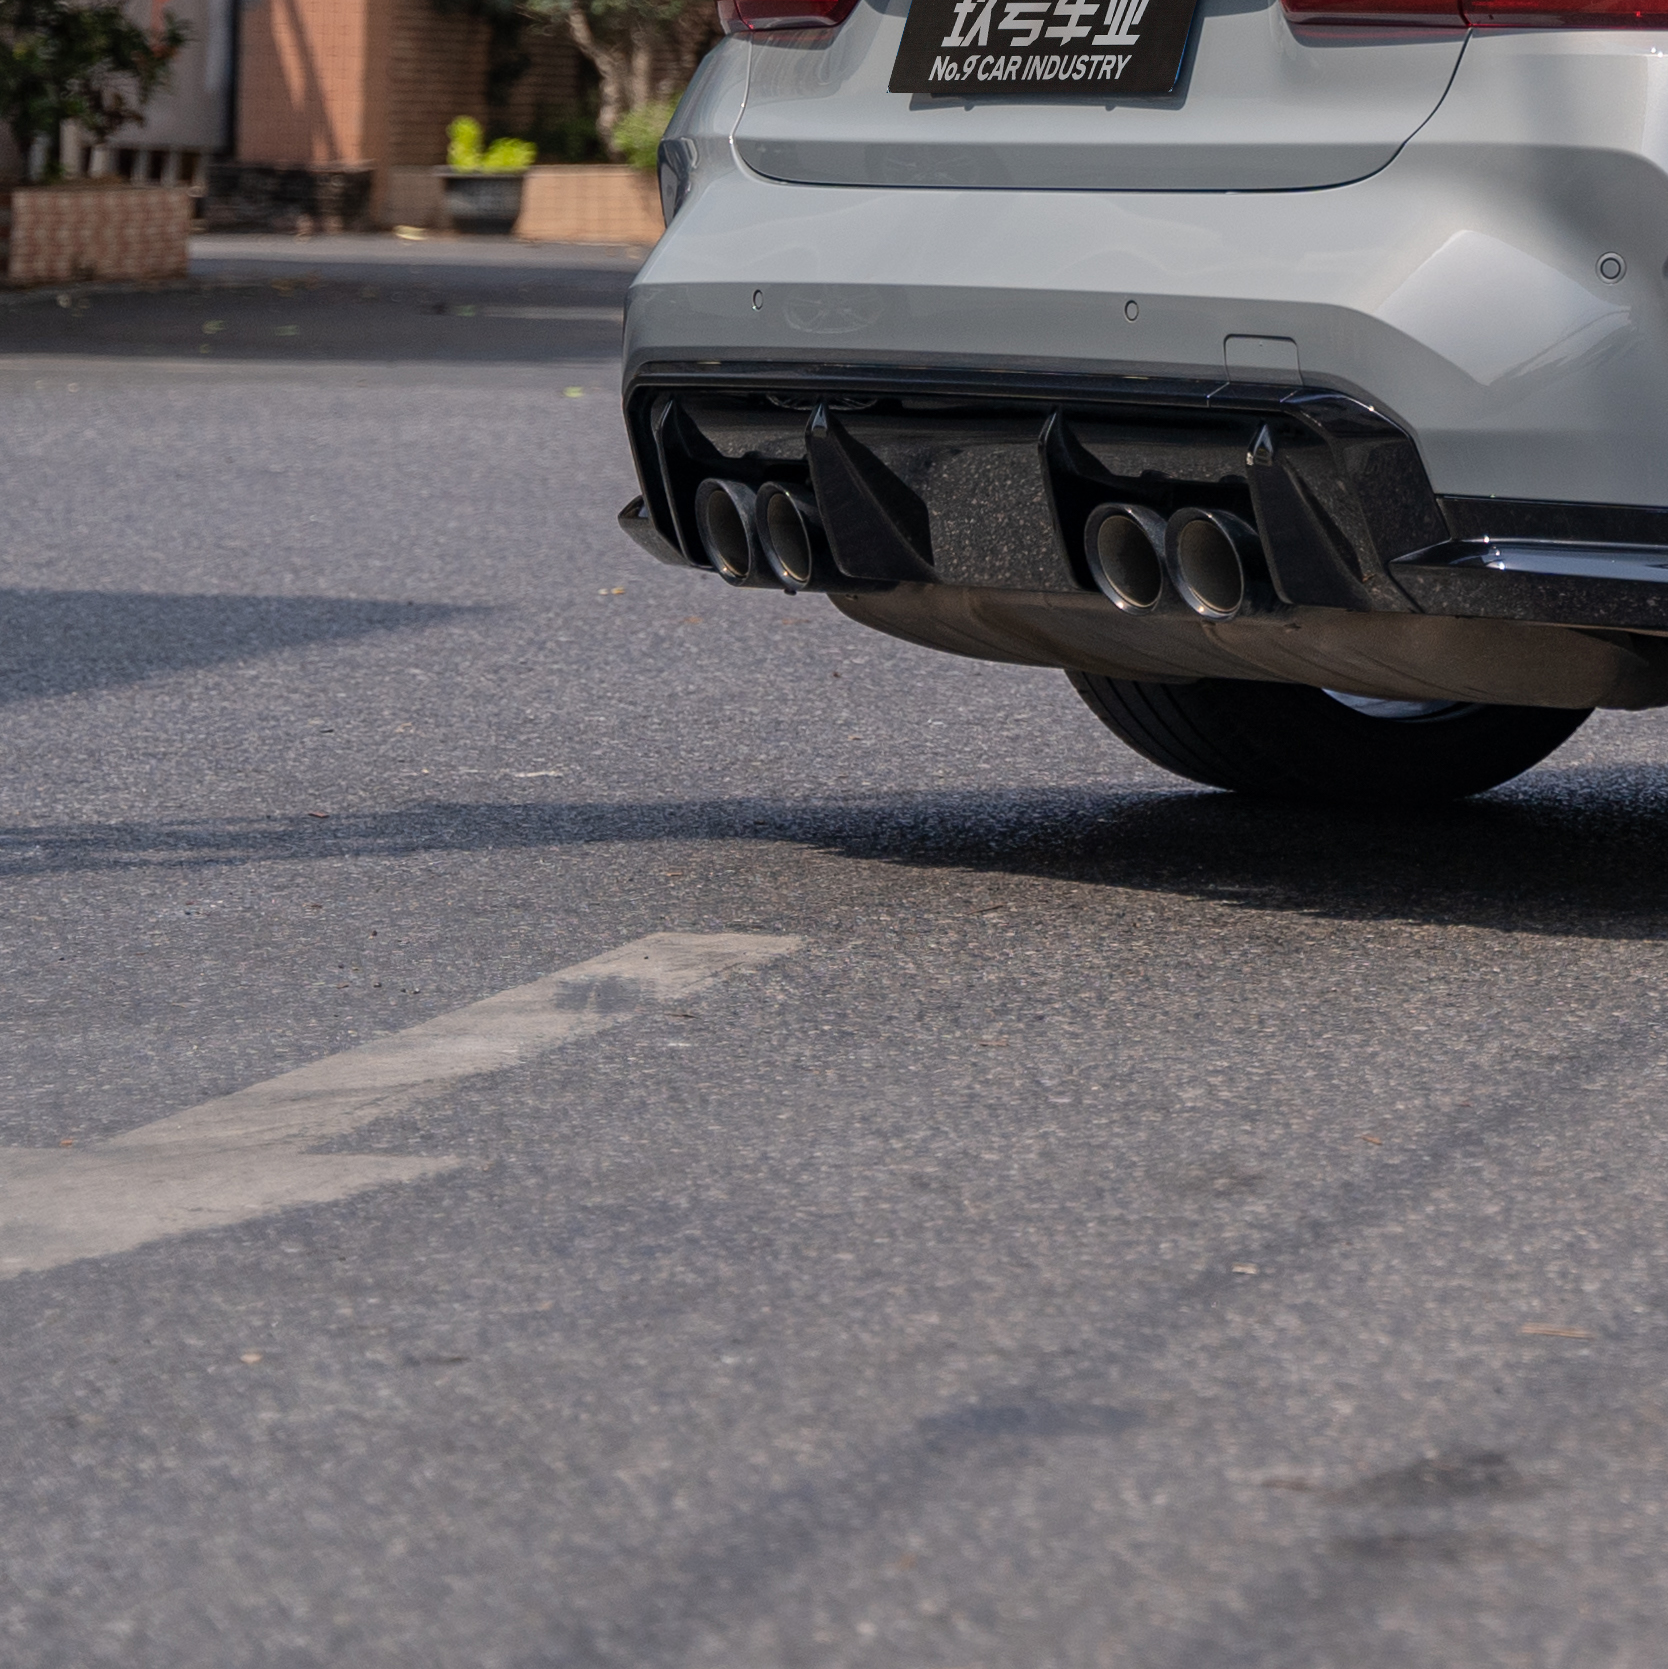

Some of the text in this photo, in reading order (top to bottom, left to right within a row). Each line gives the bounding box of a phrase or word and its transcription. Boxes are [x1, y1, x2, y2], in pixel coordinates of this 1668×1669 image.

[928, 55, 1132, 81] No.9 CAR INDUSTRY
